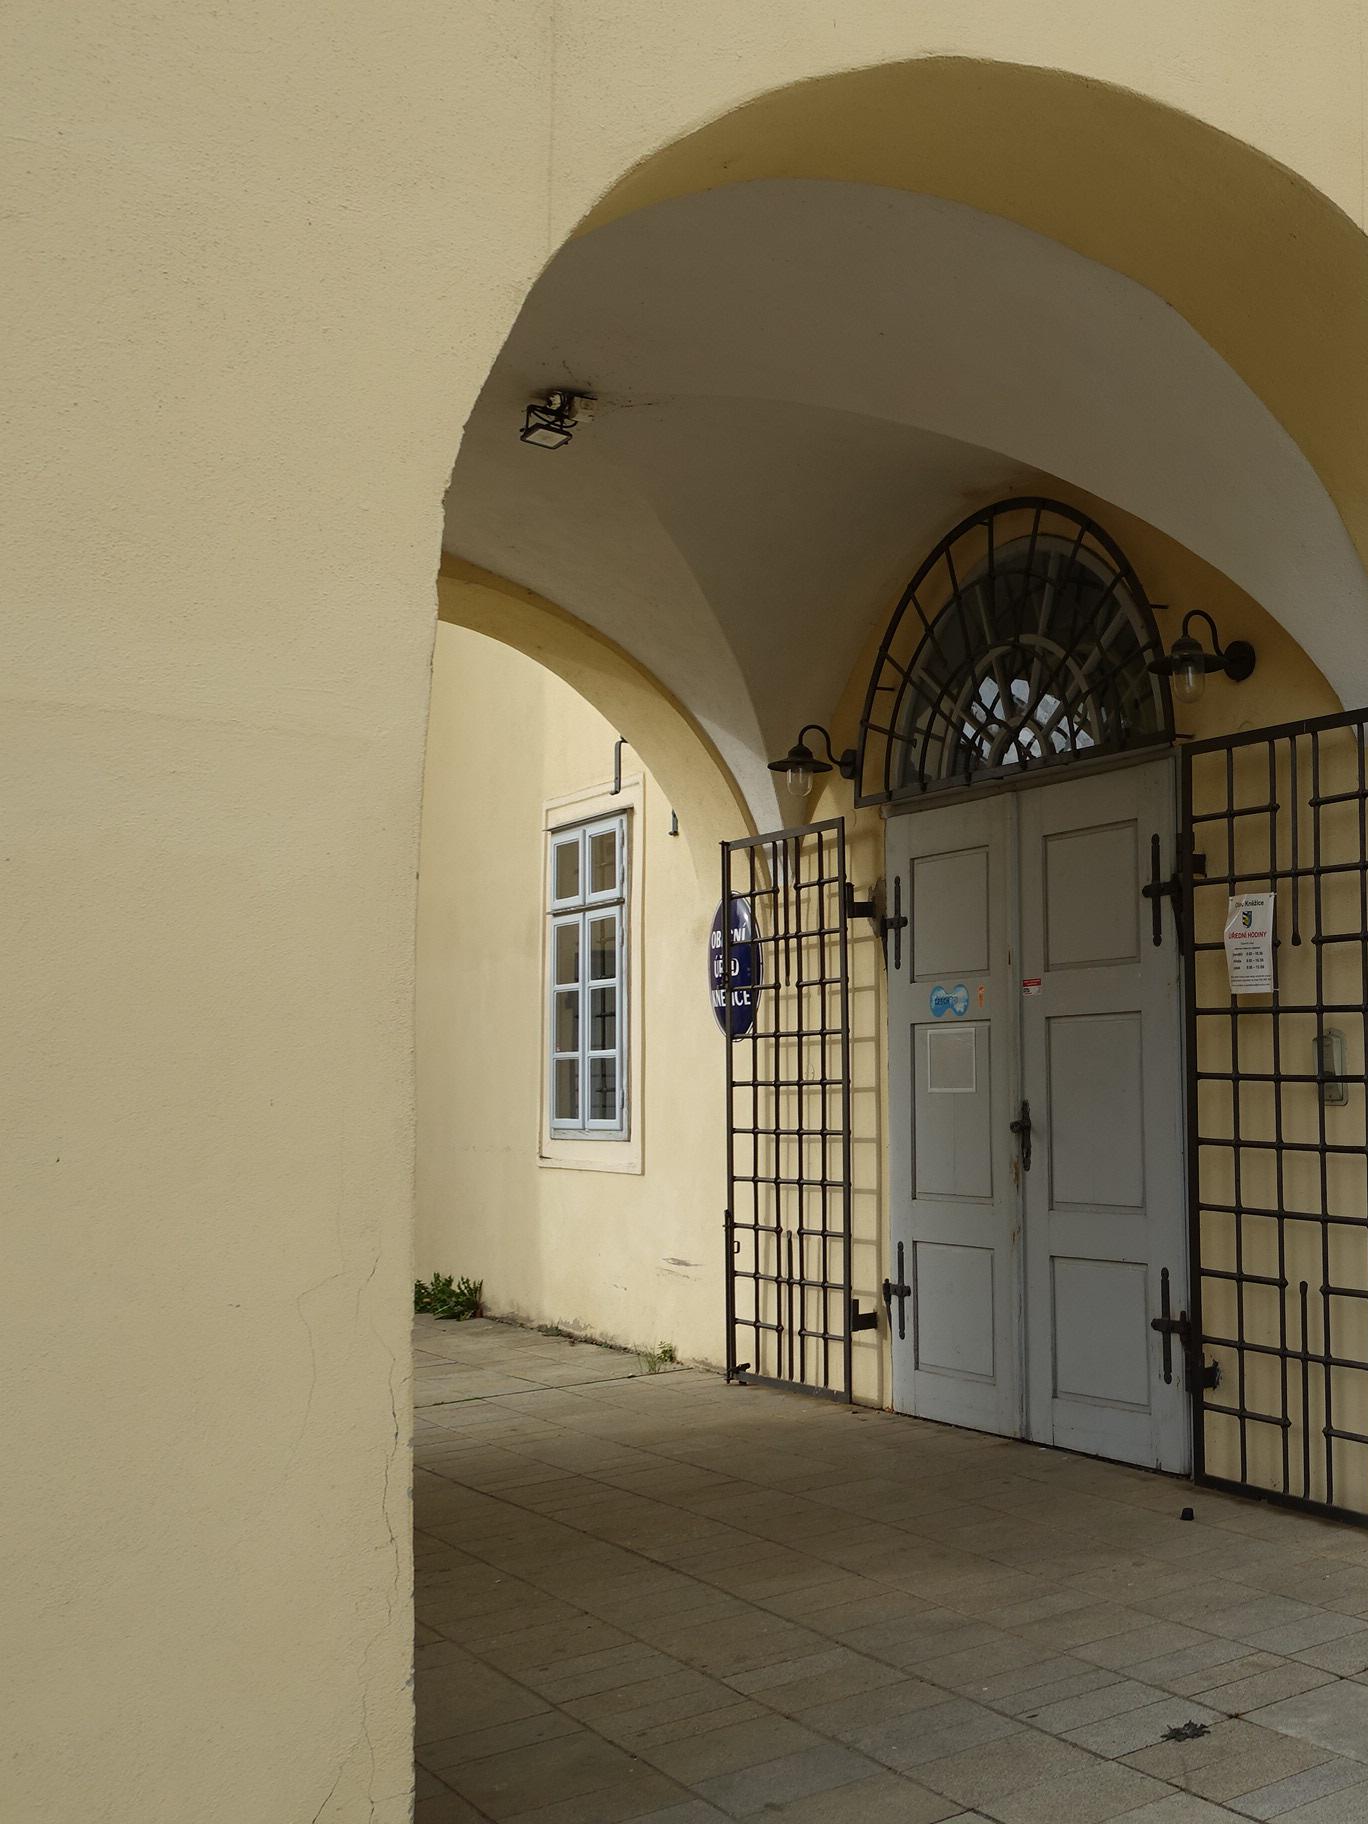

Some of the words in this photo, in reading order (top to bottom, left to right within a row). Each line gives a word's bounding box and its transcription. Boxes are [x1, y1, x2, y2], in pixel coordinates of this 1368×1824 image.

[711, 923, 746, 949] OBNÍ
[714, 955, 740, 978] ÚŘD
[712, 984, 751, 1007] KNĚICE
